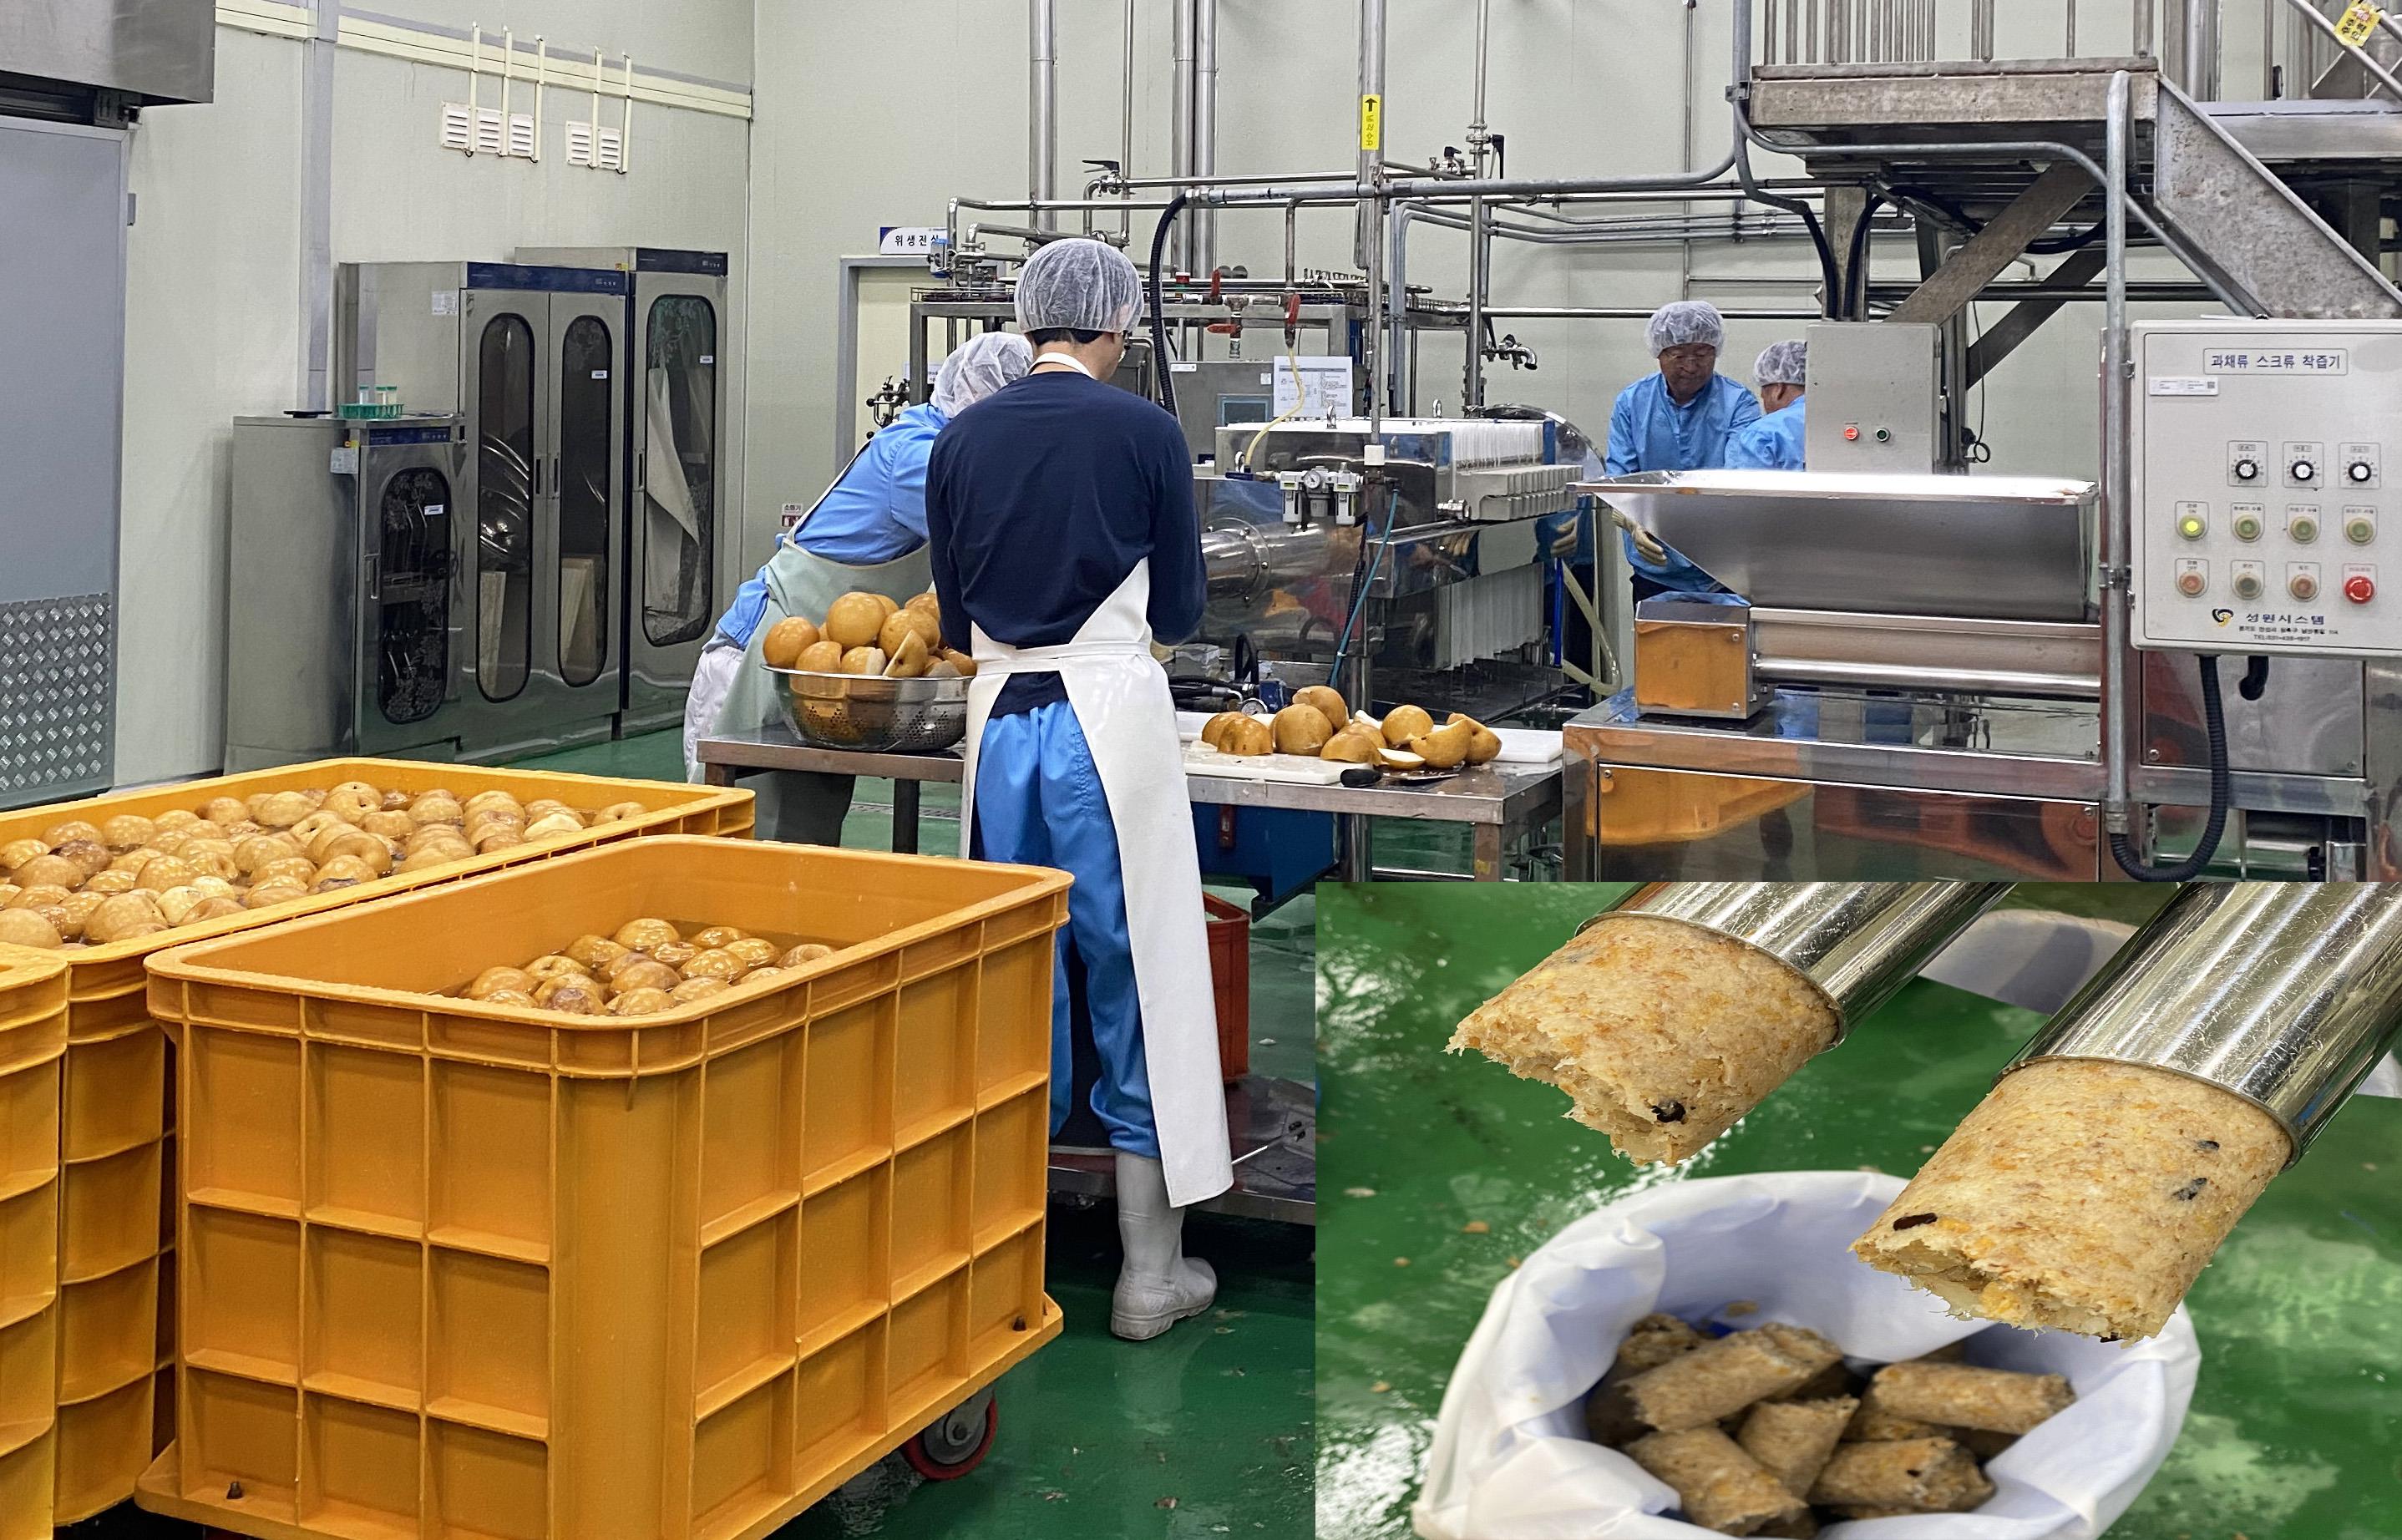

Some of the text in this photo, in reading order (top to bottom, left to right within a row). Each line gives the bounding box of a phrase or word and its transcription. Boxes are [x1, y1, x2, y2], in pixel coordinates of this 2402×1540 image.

[2211, 354, 2341, 369] 과채류 스크류 착즙기
[2246, 613, 2324, 626] 성원시스템
